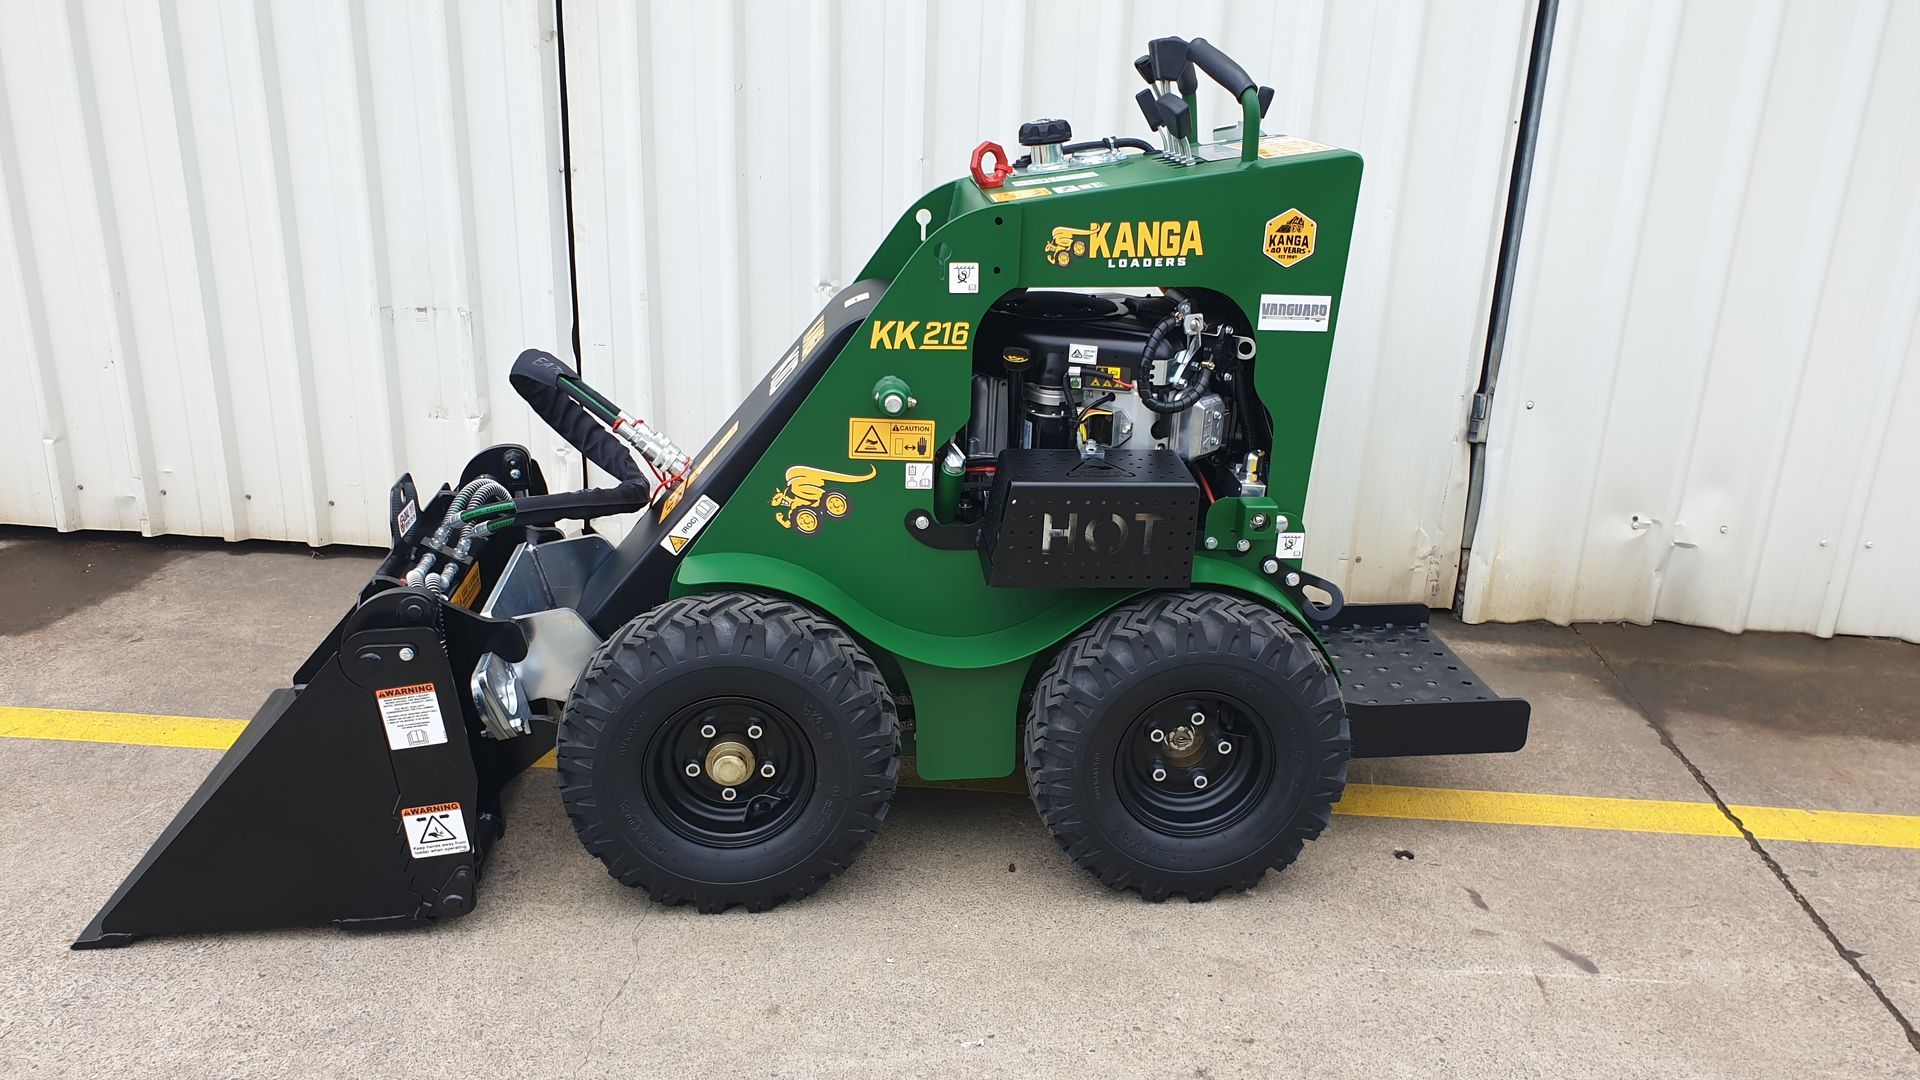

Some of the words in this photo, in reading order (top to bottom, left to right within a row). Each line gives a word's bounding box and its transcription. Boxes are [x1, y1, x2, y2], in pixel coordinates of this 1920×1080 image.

[1089, 220, 1204, 259] KANGA
[1269, 235, 1309, 249] KANGA
[1283, 247, 1307, 255] YEARS
[1107, 257, 1186, 269] LOADERS
[1261, 303, 1328, 317] VANGUARD
[870, 320, 920, 350] KK
[922, 321, 970, 346] 216
[681, 516, 699, 534] (ROC)
[1041, 512, 1166, 555] HOT
[386, 685, 433, 697] WARNING
[411, 803, 458, 815] WARNING
